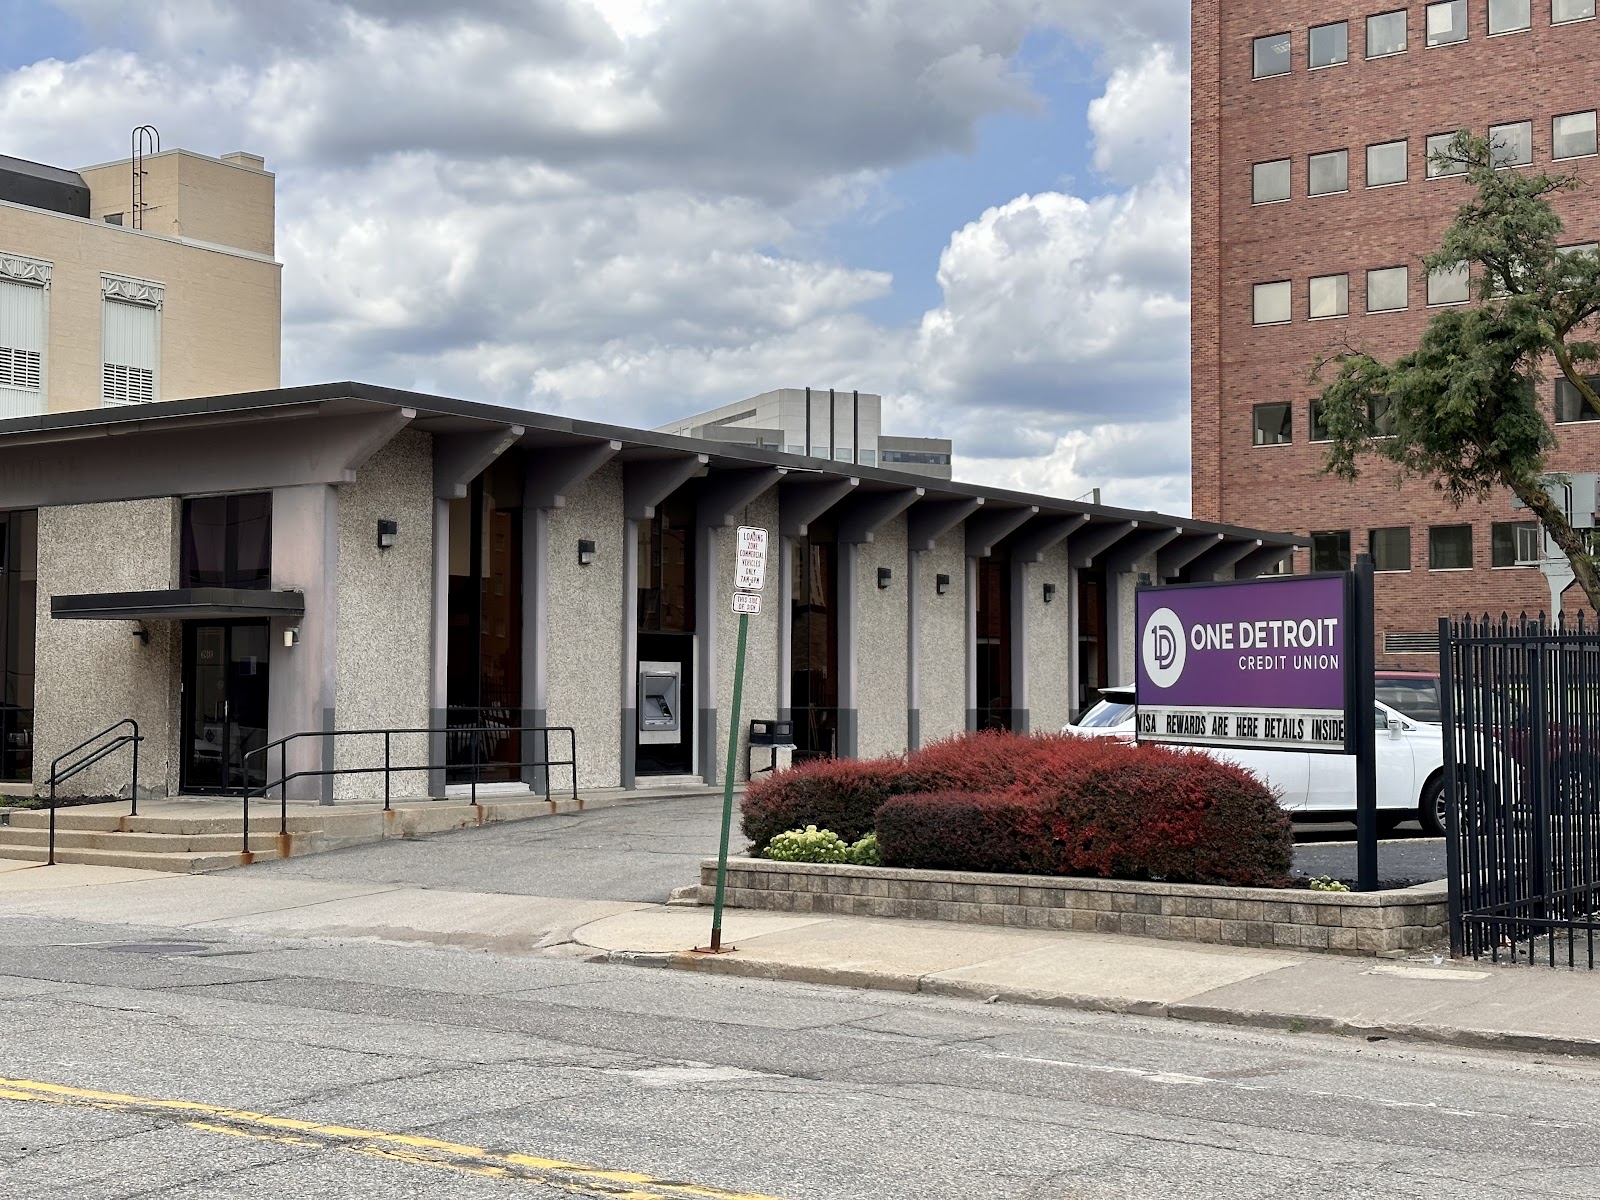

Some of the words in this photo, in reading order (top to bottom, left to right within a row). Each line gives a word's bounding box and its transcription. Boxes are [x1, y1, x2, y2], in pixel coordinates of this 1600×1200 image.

[743, 532, 763, 542] LOADING
[740, 550, 764, 559] COMMERCIAL
[742, 559, 761, 567] VEHICLES
[1191, 623, 1233, 650] ONE
[1239, 618, 1338, 648] DETROIT
[1239, 655, 1286, 670] CREDIT
[1293, 654, 1339, 670] UNION
[1136, 713, 1157, 732] VISA
[1166, 715, 1206, 735] REWARDS
[1211, 716, 1228, 736] ARE
[1236, 717, 1258, 737] HERE
[1264, 718, 1304, 739] DETAILS
[1311, 719, 1345, 740] INSIDE
